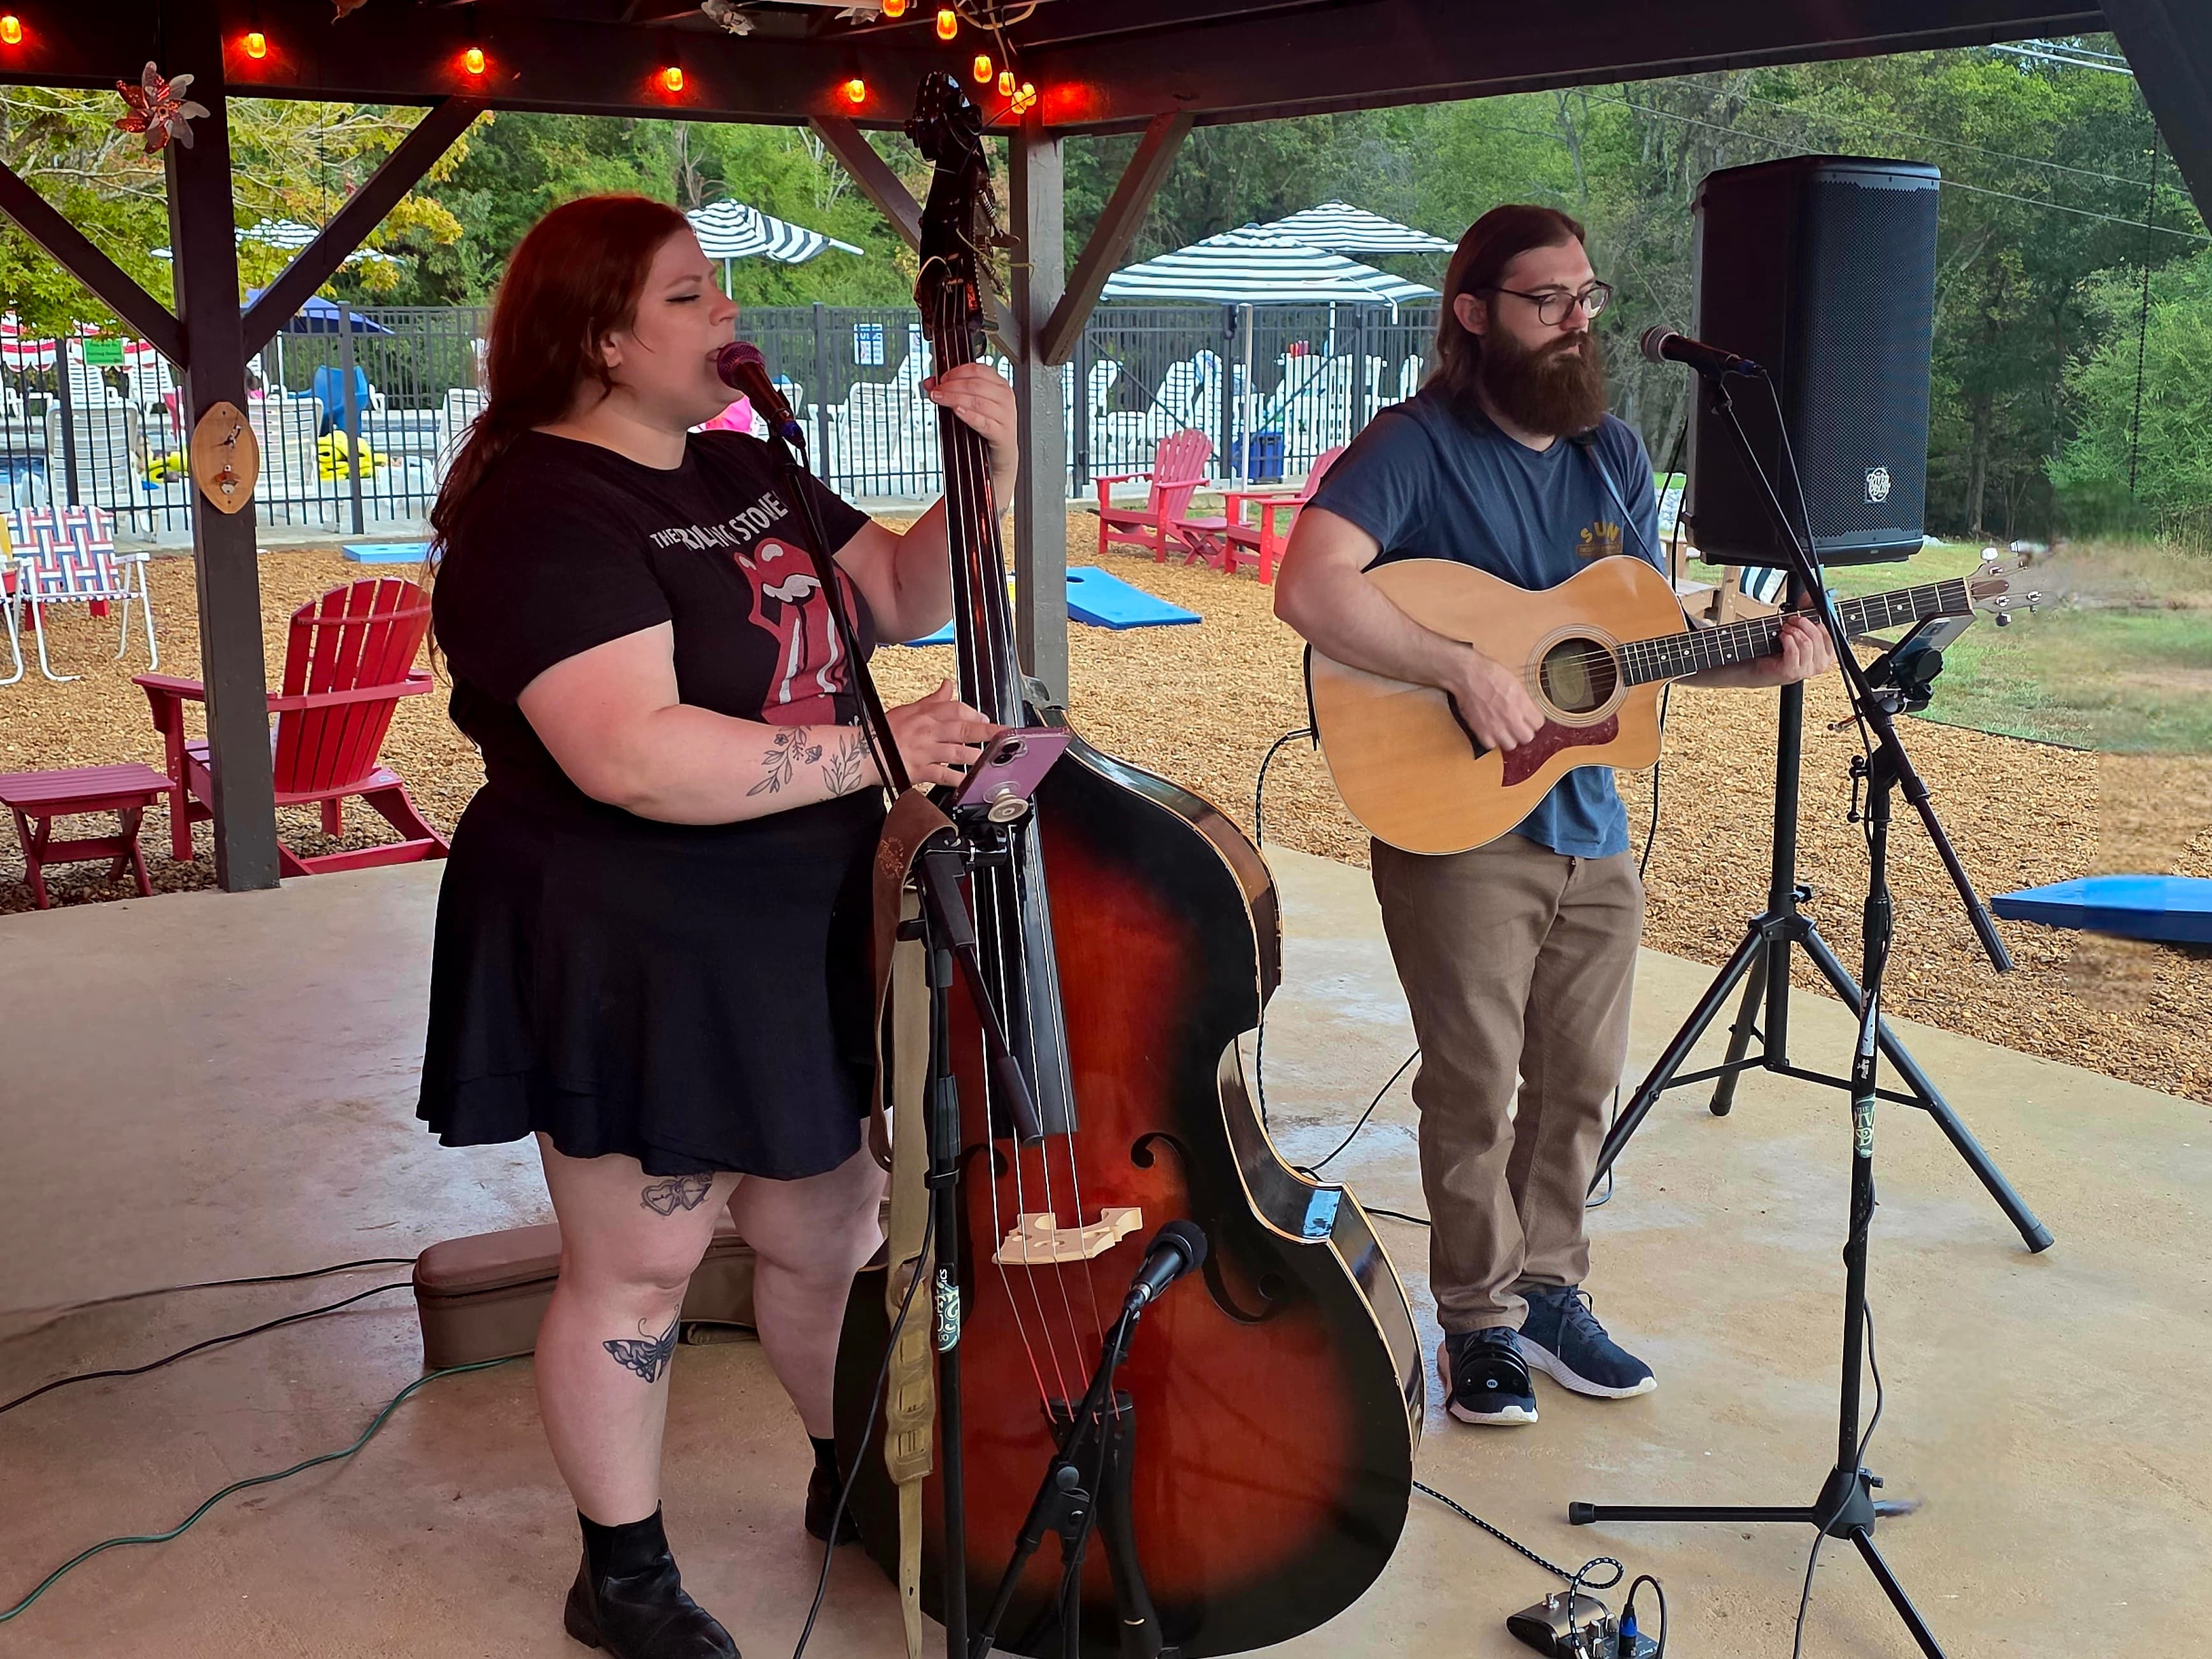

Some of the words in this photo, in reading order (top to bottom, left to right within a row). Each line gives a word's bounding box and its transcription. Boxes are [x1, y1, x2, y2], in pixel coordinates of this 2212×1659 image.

[650, 529, 681, 548] THE
[729, 490, 788, 541] STONE
[1580, 521, 1620, 543] SUN
